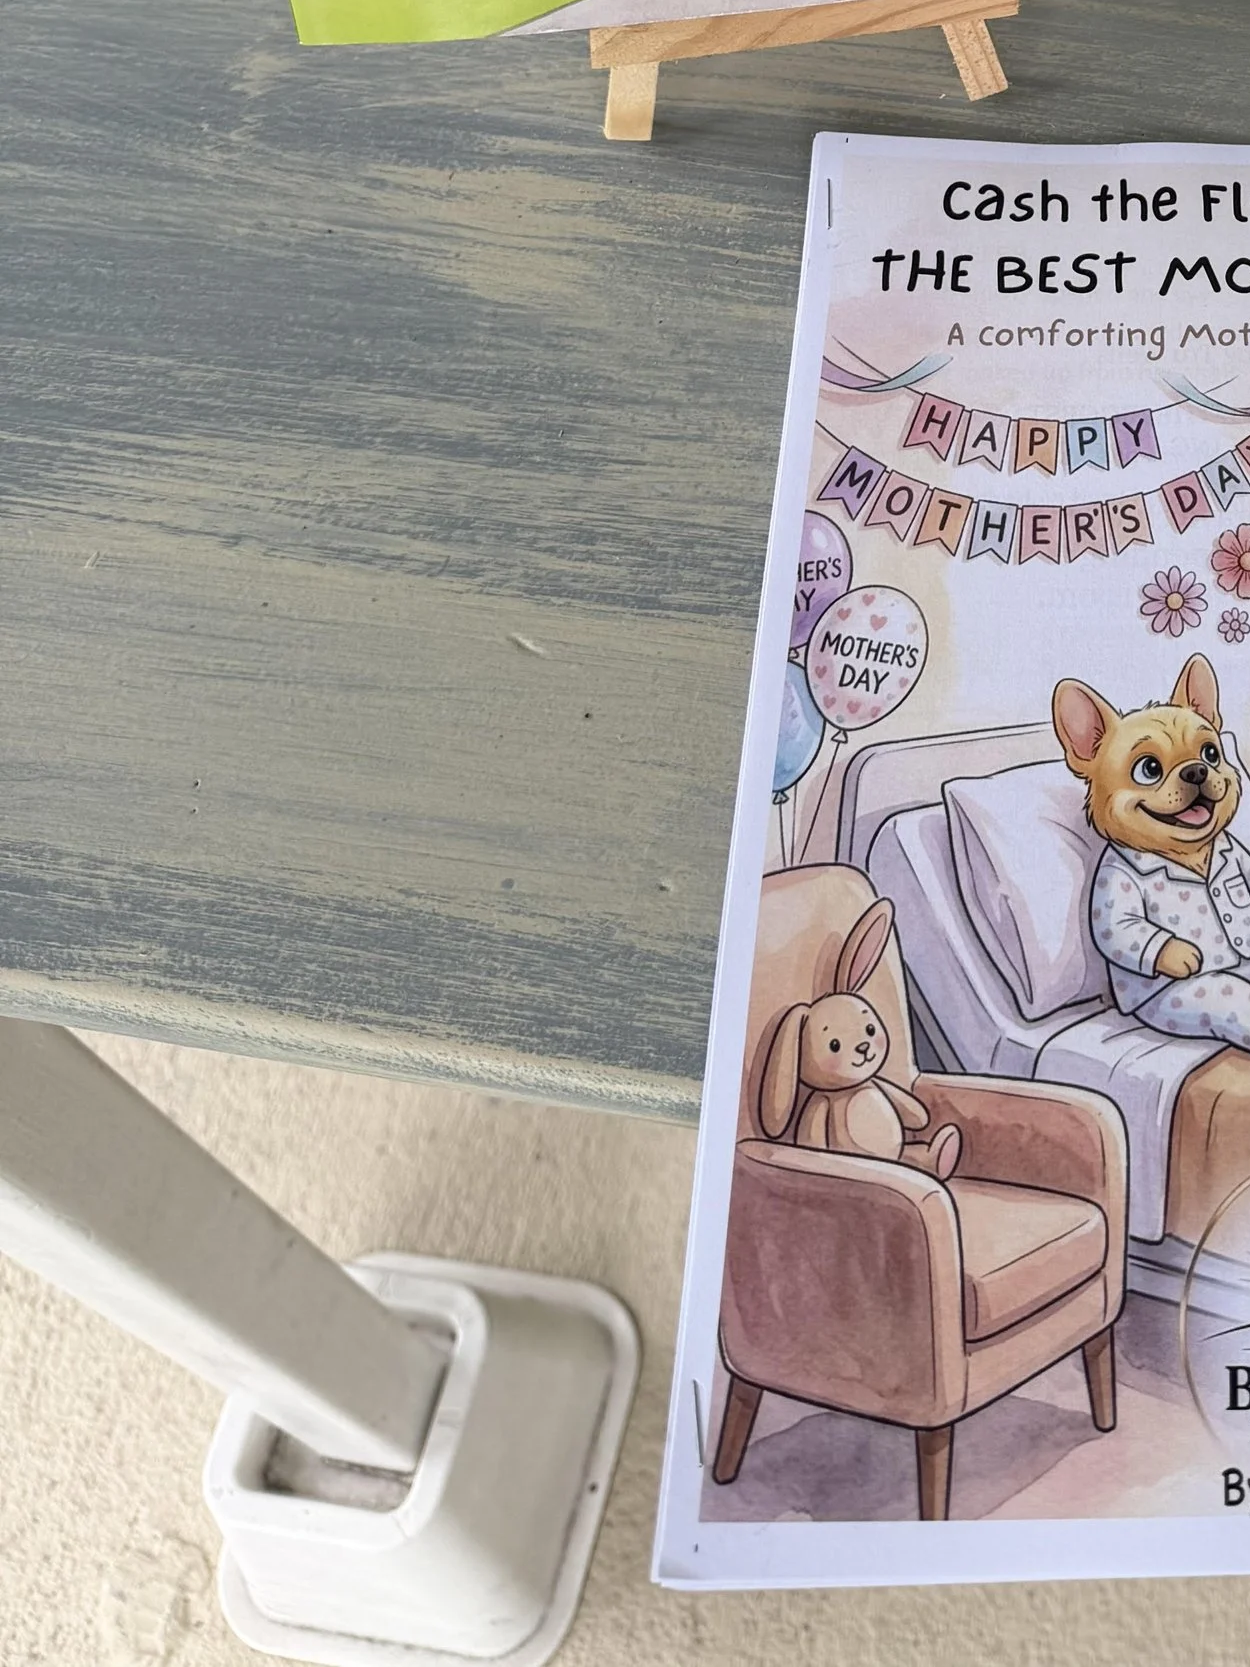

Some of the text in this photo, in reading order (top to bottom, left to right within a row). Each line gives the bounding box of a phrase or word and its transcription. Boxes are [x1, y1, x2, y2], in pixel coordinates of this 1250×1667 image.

[942, 179, 1070, 224] Cash
[1092, 181, 1179, 223] the
[872, 248, 973, 293] THE
[997, 251, 1137, 295] BEST
[947, 323, 964, 346] A
[977, 320, 1166, 360] comforting
[924, 405, 1147, 456] HAPPY
[820, 631, 919, 668] MOTHER'S
[838, 664, 890, 695] DAY
